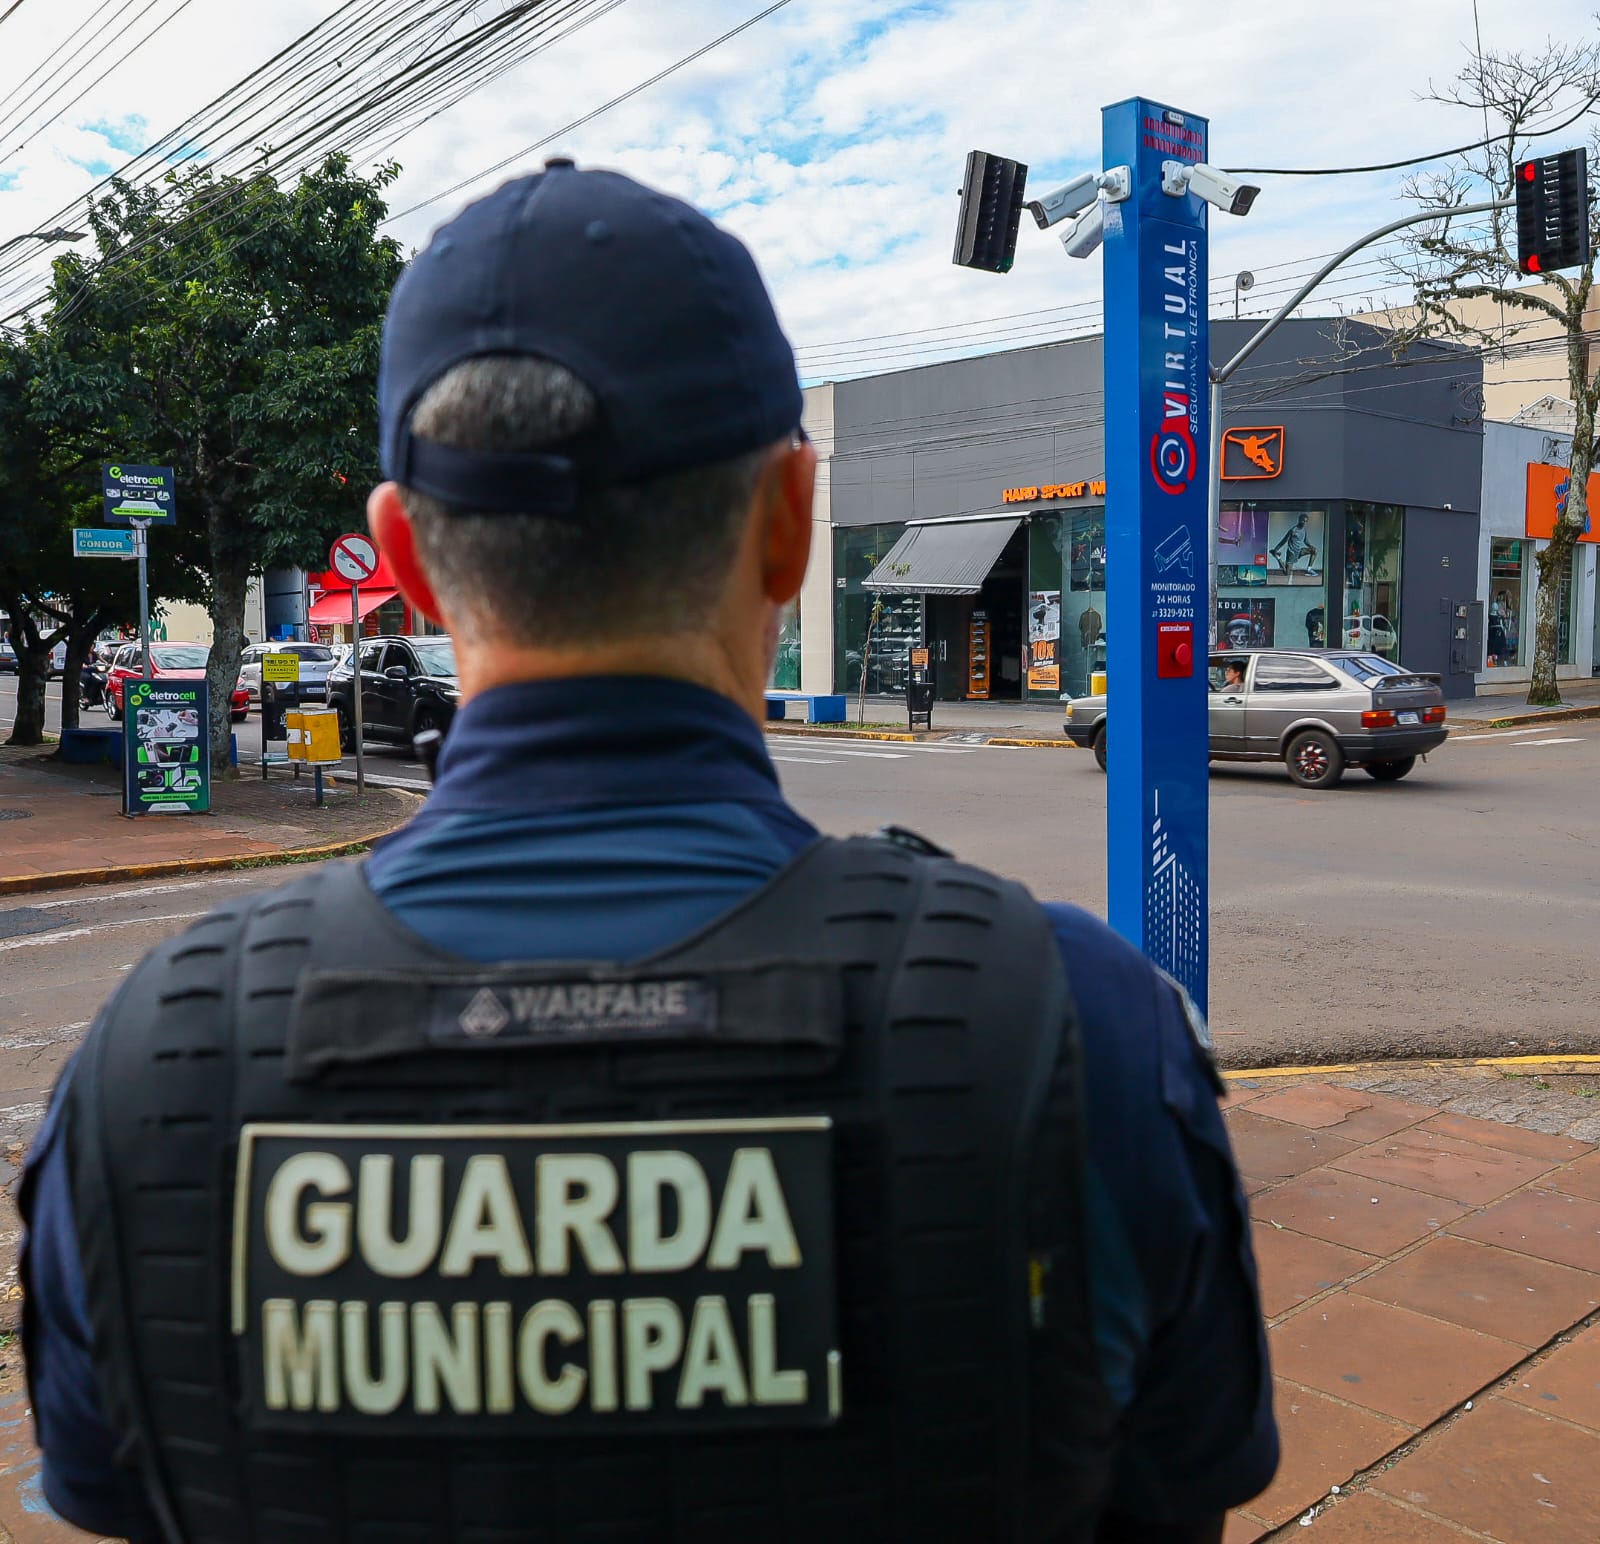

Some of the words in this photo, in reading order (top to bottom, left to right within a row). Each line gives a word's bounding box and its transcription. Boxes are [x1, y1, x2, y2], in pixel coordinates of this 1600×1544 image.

[1188, 240, 1198, 337] ELETRÔNICA
[1164, 239, 1187, 418] VIRTUAL
[119, 474, 164, 486] eletrocell
[1003, 486, 1038, 503] HARD
[1040, 482, 1086, 499] SPORT
[79, 531, 92, 539] RUA
[80, 540, 123, 549] CONDOR
[1151, 582, 1196, 592] MONITORADO
[1156, 594, 1166, 605] 24
[1167, 594, 1191, 605] HORAS
[149, 691, 196, 701] eletrocell
[509, 982, 688, 1022] WARFARE
[265, 1147, 803, 1277] GUARDA
[262, 1293, 808, 1415] MUNICIPAL
